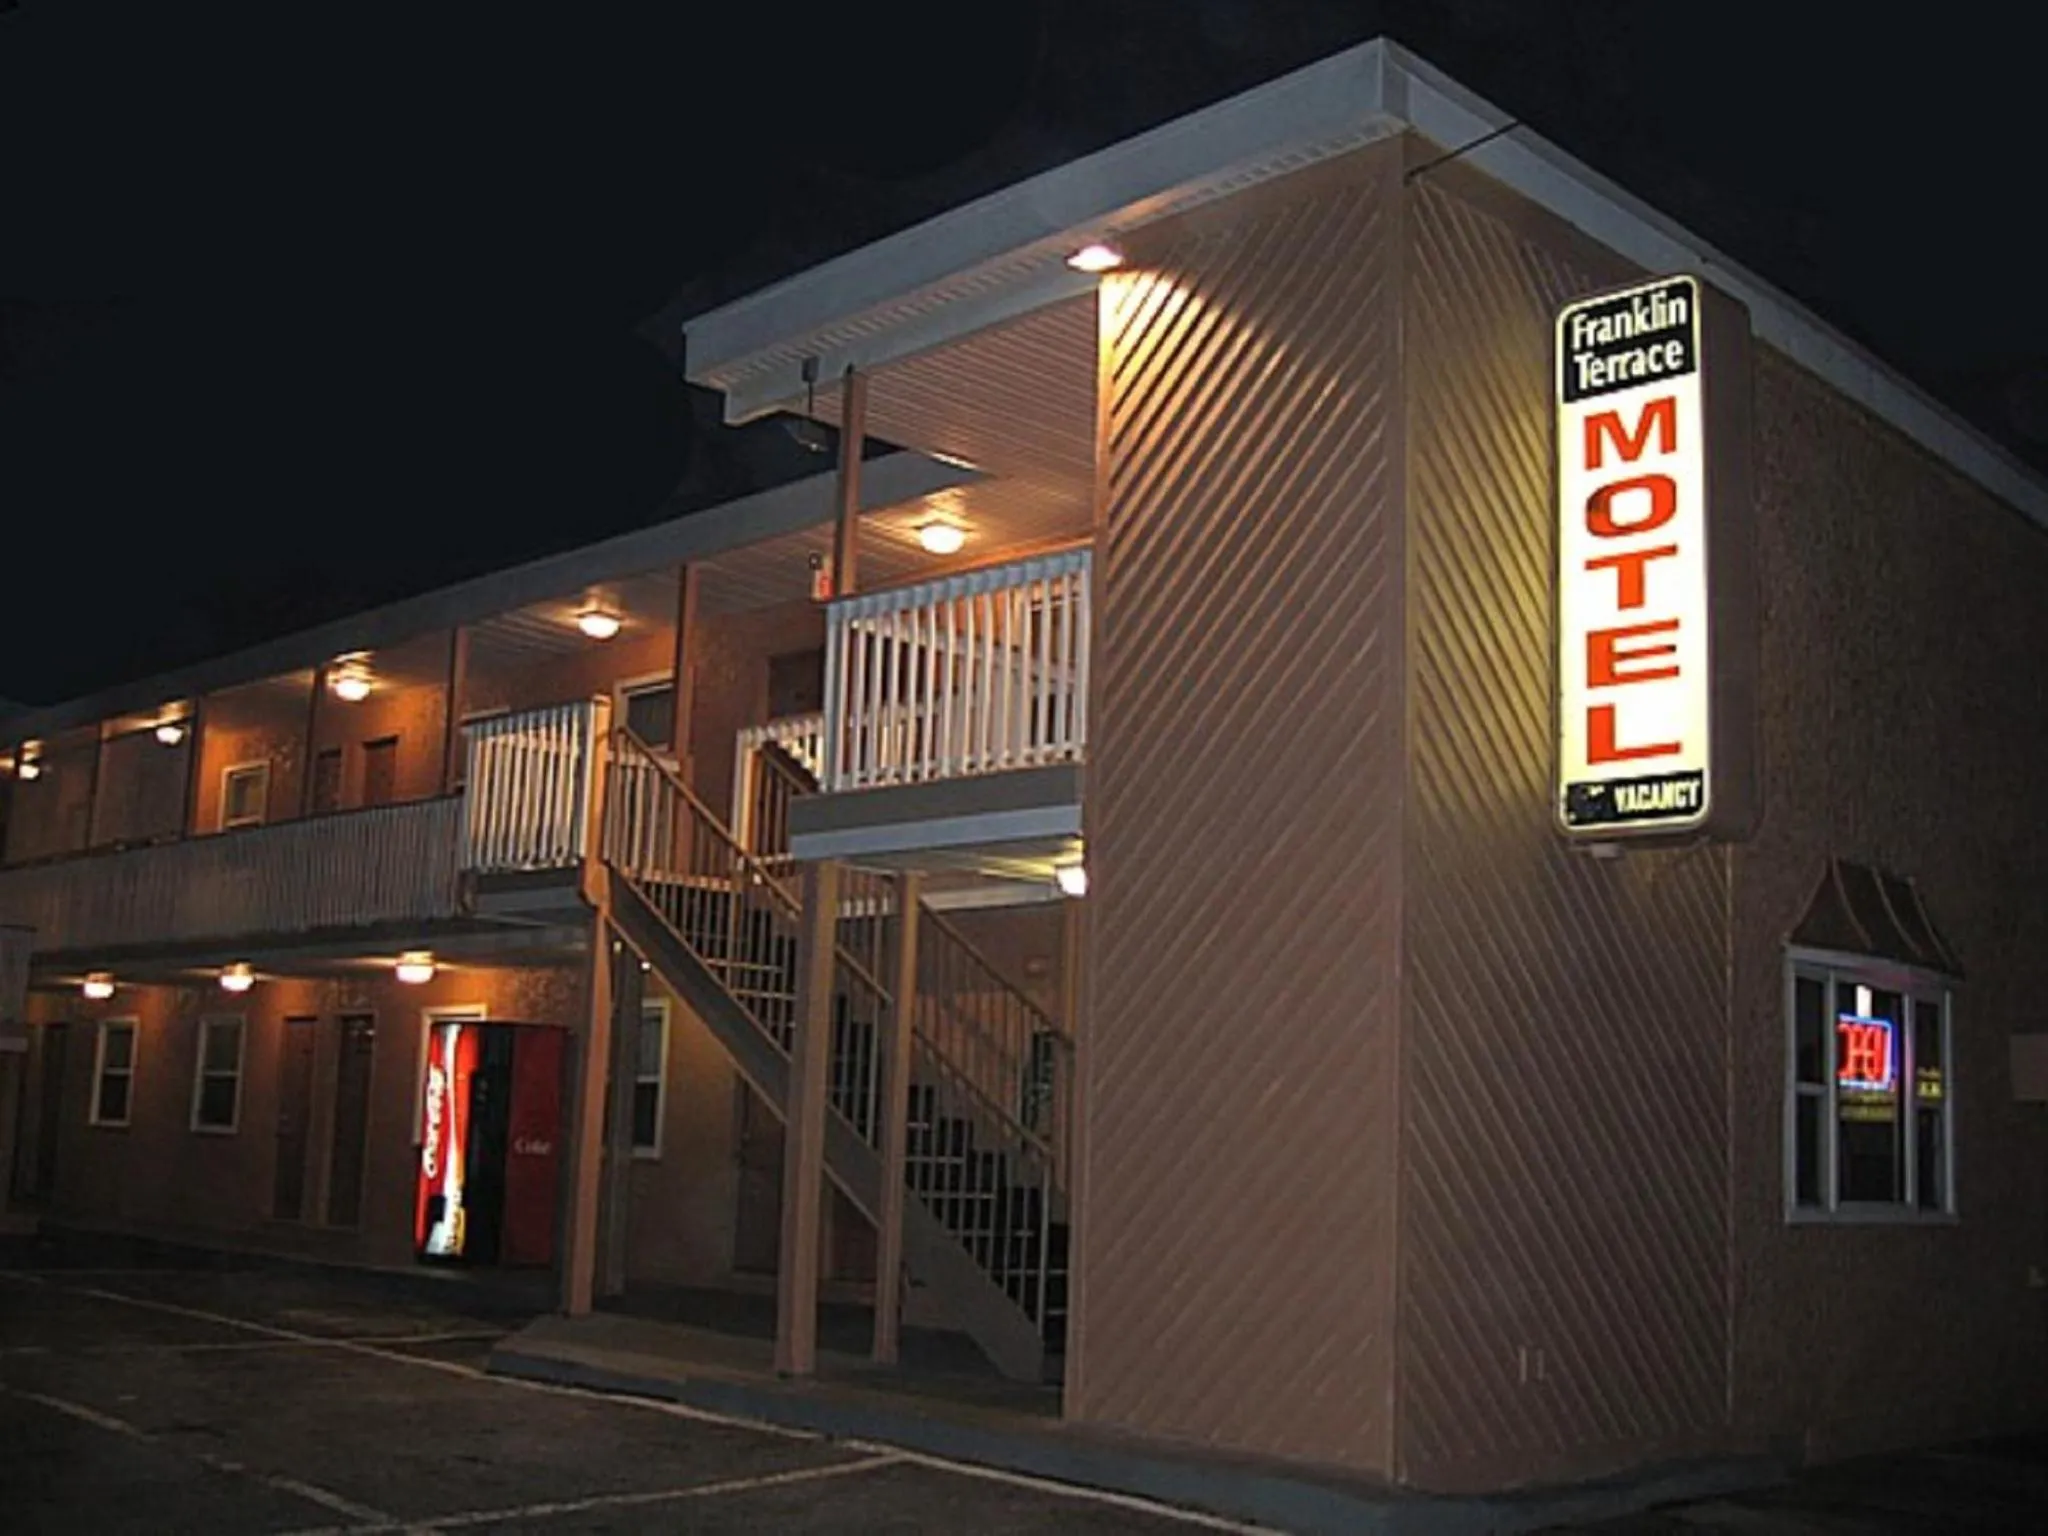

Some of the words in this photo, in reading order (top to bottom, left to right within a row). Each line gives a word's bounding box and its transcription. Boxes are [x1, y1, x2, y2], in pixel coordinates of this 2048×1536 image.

[1571, 289, 1687, 350] Franklin
[1573, 338, 1684, 390] Terrace
[1584, 395, 1681, 765] MOTEL
[1614, 780, 1700, 813] VACANCY
